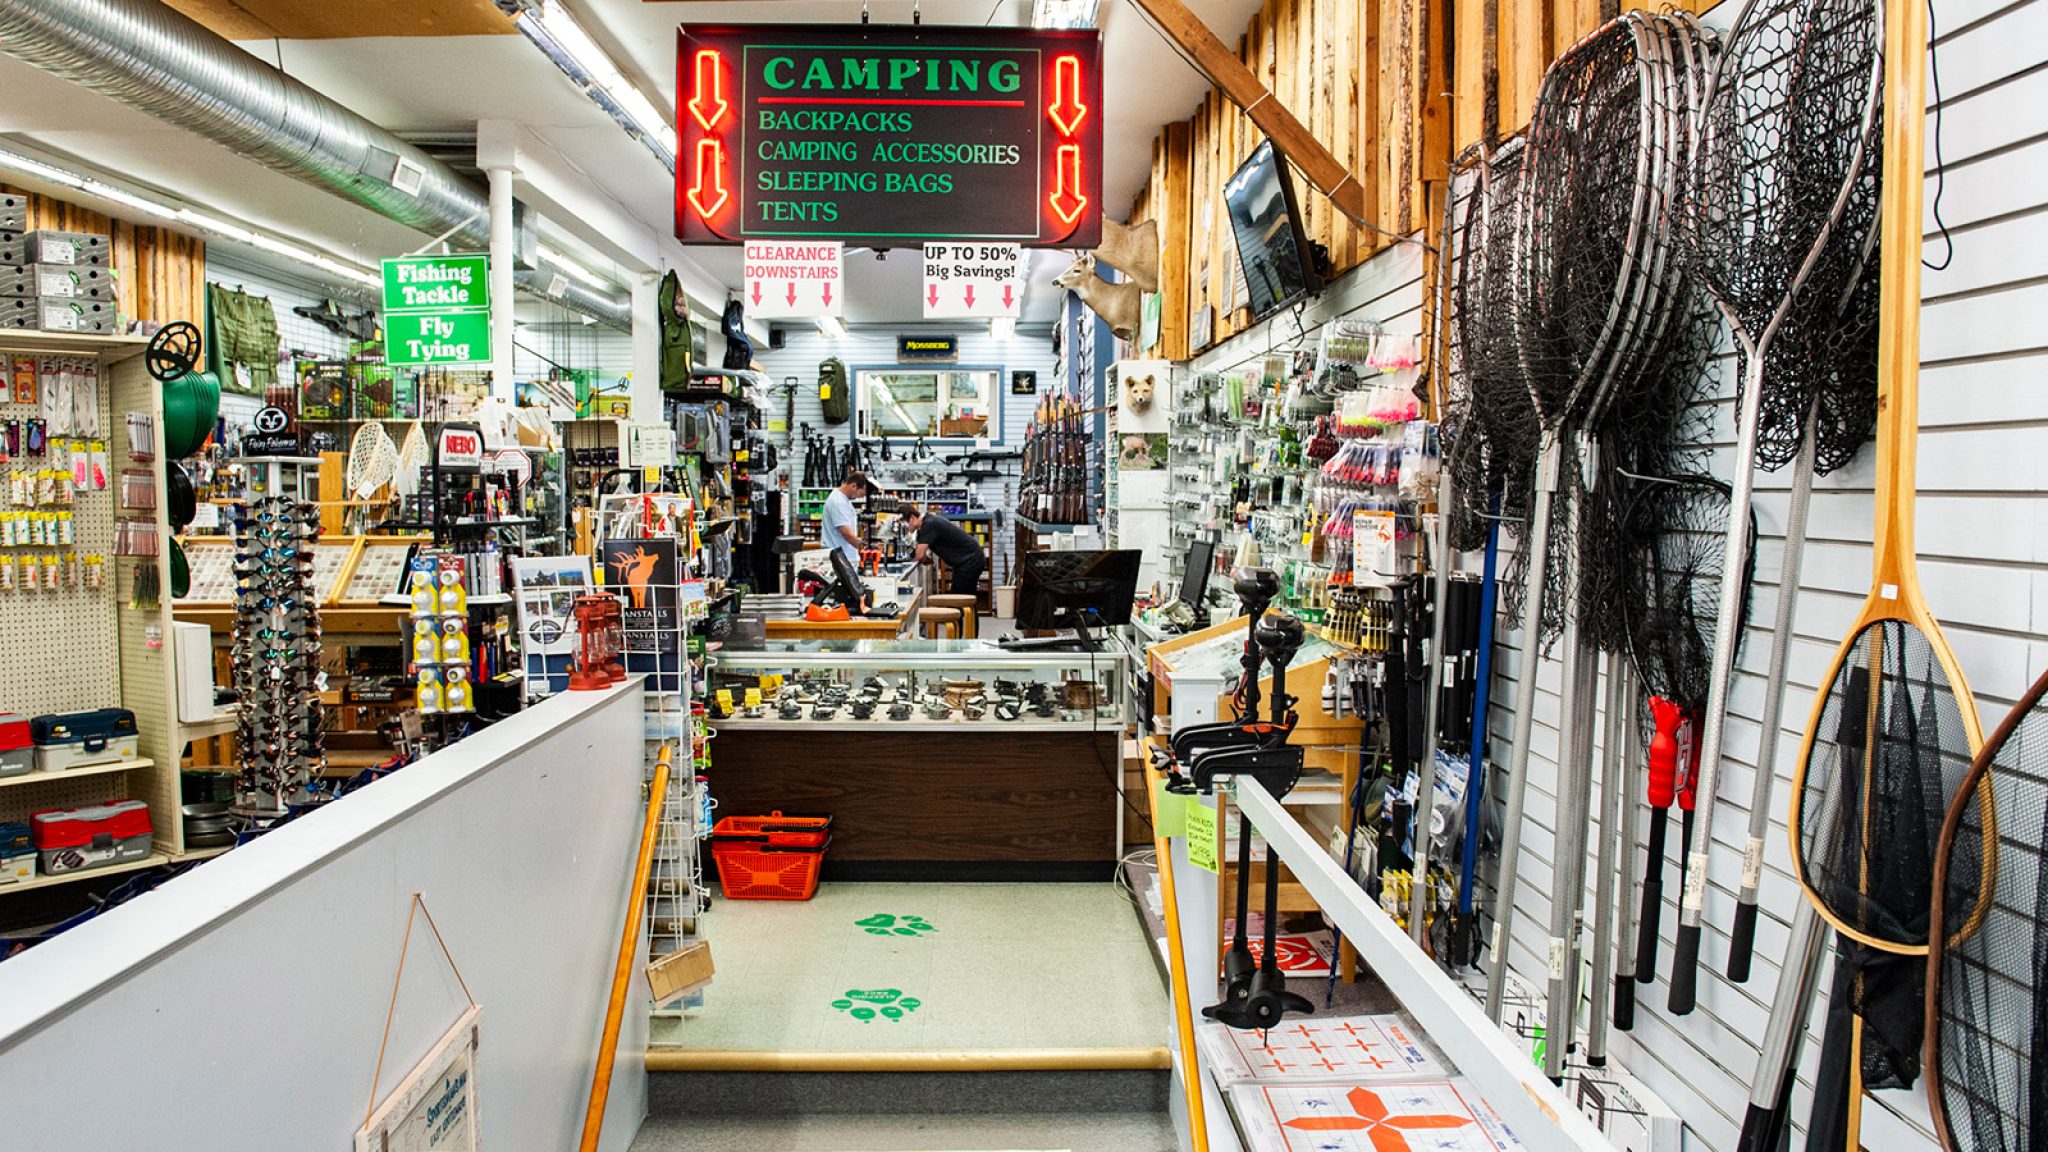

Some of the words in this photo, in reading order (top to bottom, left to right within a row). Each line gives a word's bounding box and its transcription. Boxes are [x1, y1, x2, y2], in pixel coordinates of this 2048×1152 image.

[763, 57, 1021, 92] CAMPING
[758, 110, 912, 132] BACKPACKS
[758, 141, 857, 162] CAMPING
[872, 143, 1020, 165] ACCESSORIES
[757, 171, 877, 193] SLEEPING
[885, 173, 953, 194] BAGS
[757, 201, 838, 222] TENTS
[745, 246, 836, 262] CLEARANCE
[925, 246, 945, 261] UP
[950, 246, 975, 261] TO
[979, 247, 1017, 262] 50%
[397, 263, 472, 285] Fishing
[745, 264, 838, 280] DOWNSTAIRS
[926, 264, 950, 281] Big
[954, 264, 1016, 281] Savings!
[402, 286, 469, 306] Tackle
[419, 317, 454, 339] Fly
[406, 340, 470, 362] Tying
[446, 435, 476, 455] NEBO
